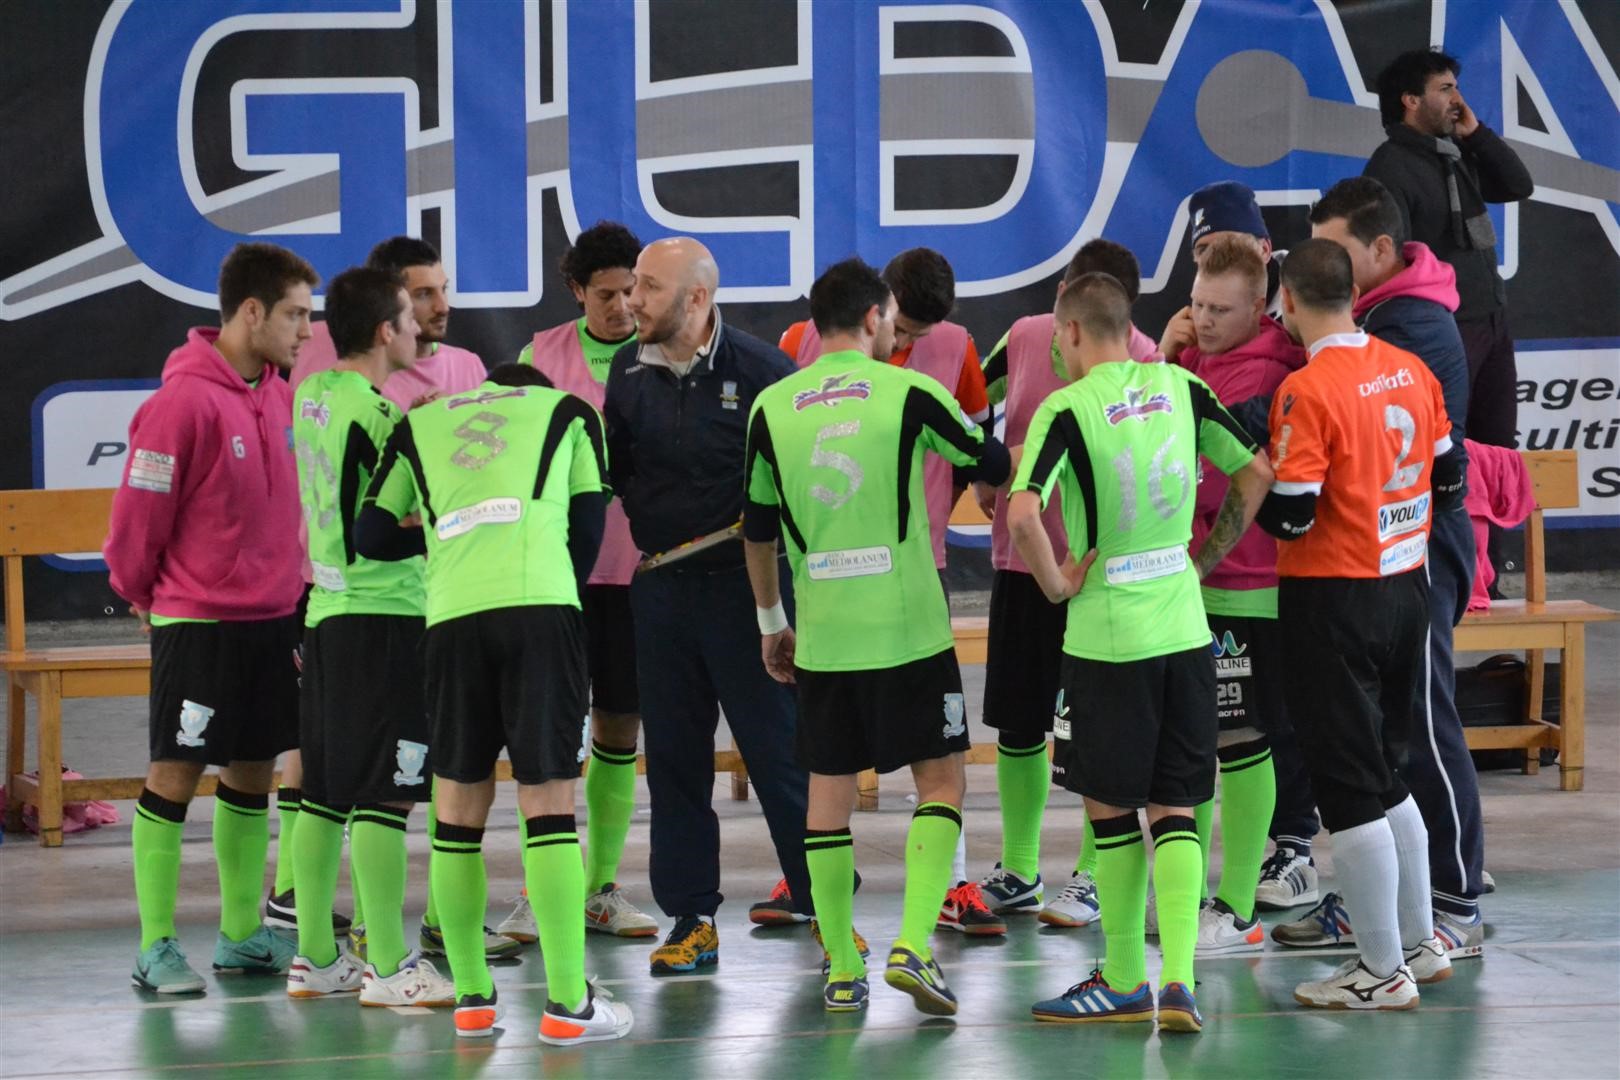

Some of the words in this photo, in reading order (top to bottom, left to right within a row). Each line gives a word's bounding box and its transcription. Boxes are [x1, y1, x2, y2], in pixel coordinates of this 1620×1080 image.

[1516, 377, 1620, 410] age
[451, 411, 509, 471] 8
[810, 420, 864, 510] 5
[1382, 404, 1425, 492] 2
[1114, 433, 1190, 532] 16
[1217, 682, 1242, 706] 29
[833, 990, 855, 1000] NIKE
